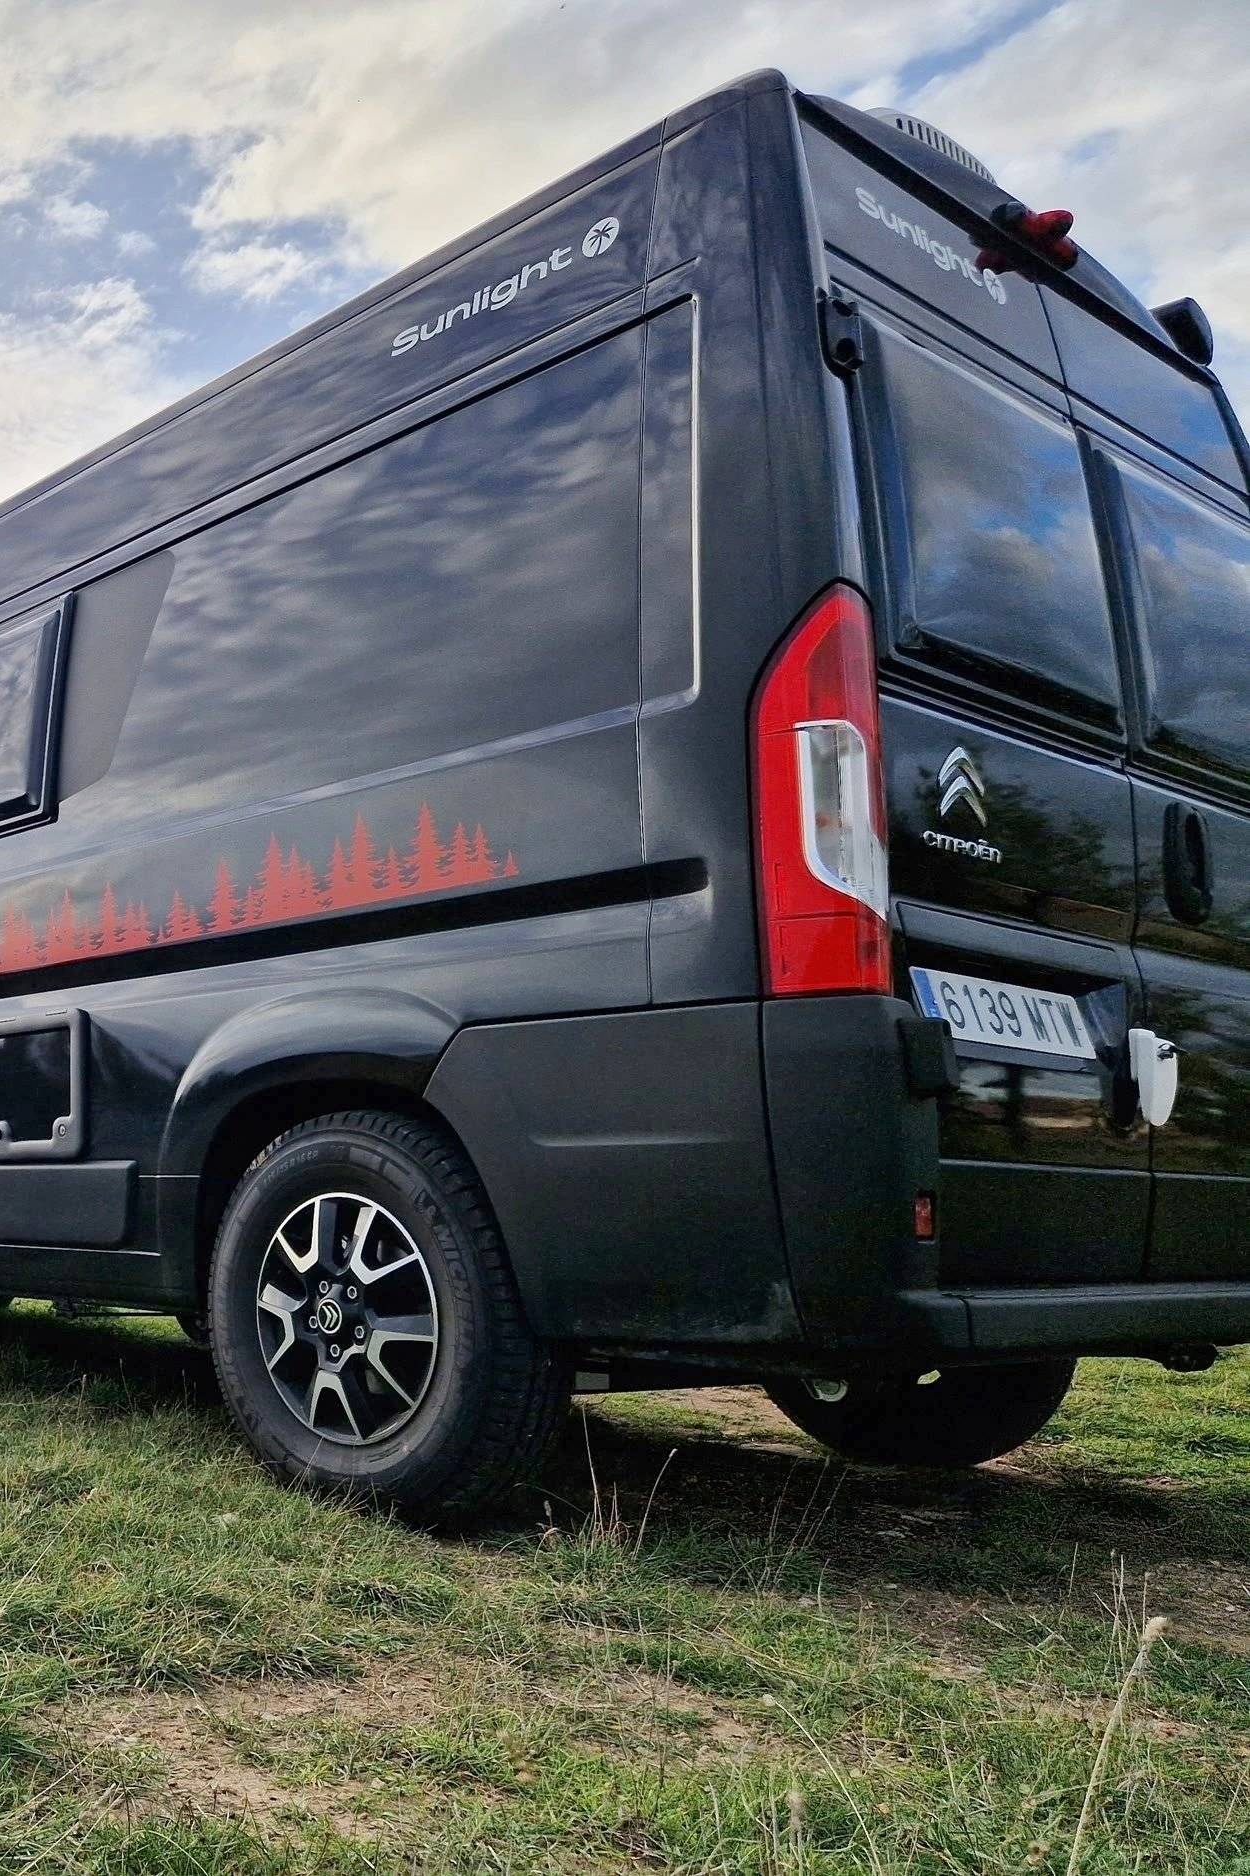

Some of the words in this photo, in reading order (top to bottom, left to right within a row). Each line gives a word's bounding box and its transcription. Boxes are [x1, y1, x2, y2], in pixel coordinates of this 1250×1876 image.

[855, 187, 984, 287] Sunlight
[391, 246, 572, 357] Sunlight
[940, 981, 1022, 1037] 6139
[1021, 995, 1082, 1048] MTW
